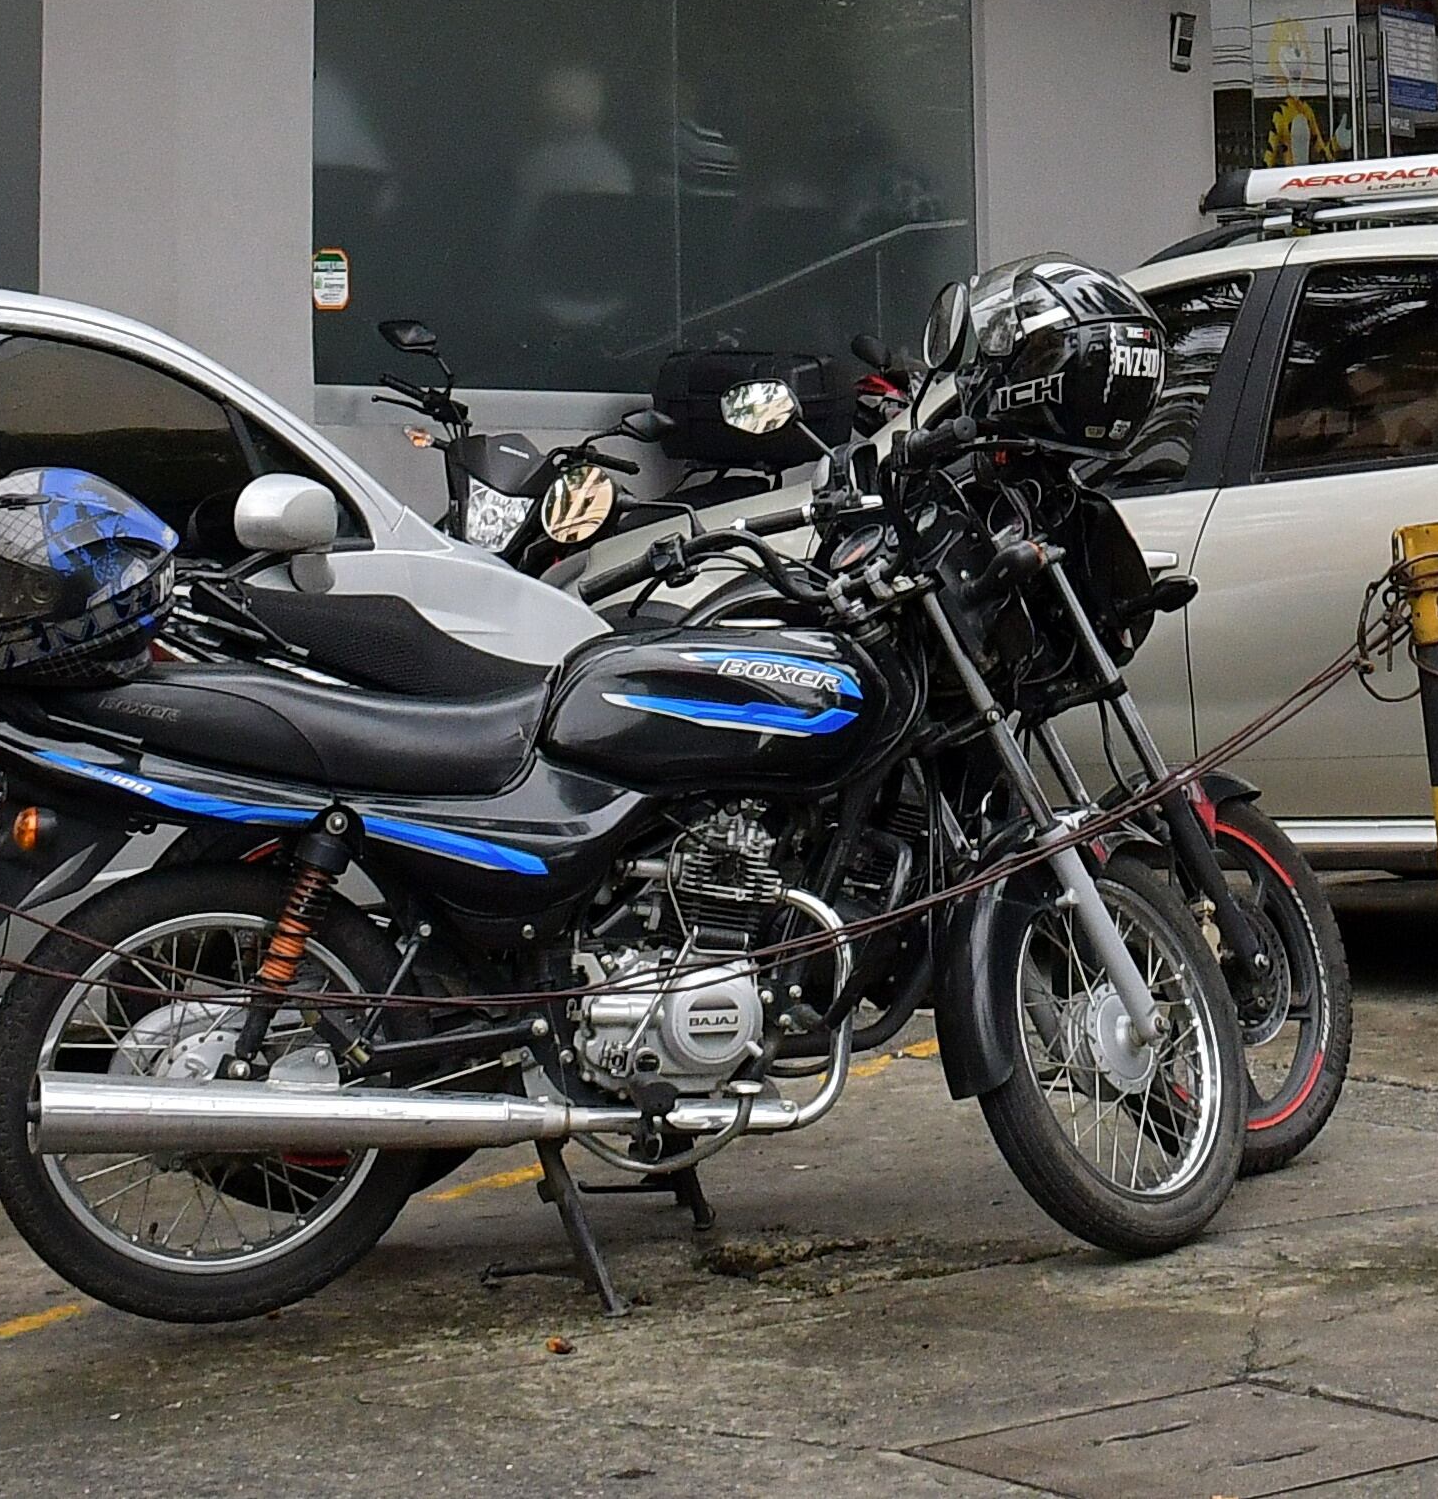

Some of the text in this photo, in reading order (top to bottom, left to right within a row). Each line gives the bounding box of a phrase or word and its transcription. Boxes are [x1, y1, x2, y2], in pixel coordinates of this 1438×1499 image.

[1366, 179, 1432, 191] LIGHT
[717, 658, 842, 693] BOXER
[688, 1014, 739, 1027] BAJAJ
